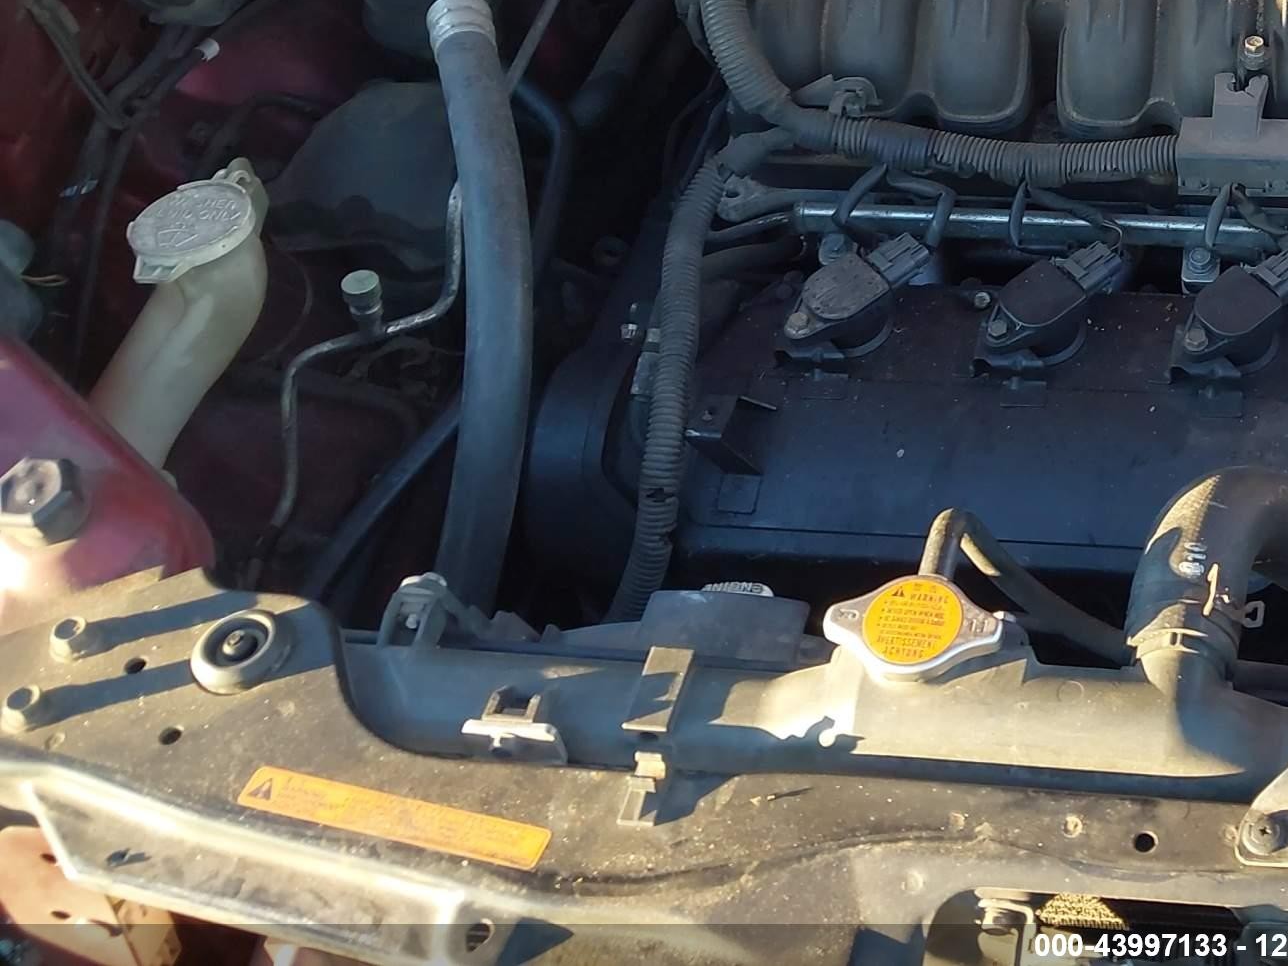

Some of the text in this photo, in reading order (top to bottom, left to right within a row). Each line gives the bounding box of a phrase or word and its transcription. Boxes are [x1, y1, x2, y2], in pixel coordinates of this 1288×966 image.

[199, 210, 241, 221] ONLY
[909, 593, 949, 604] WARNING
[876, 636, 937, 649] AVERTISSEMENT
[881, 646, 925, 659] ACHTUNG
